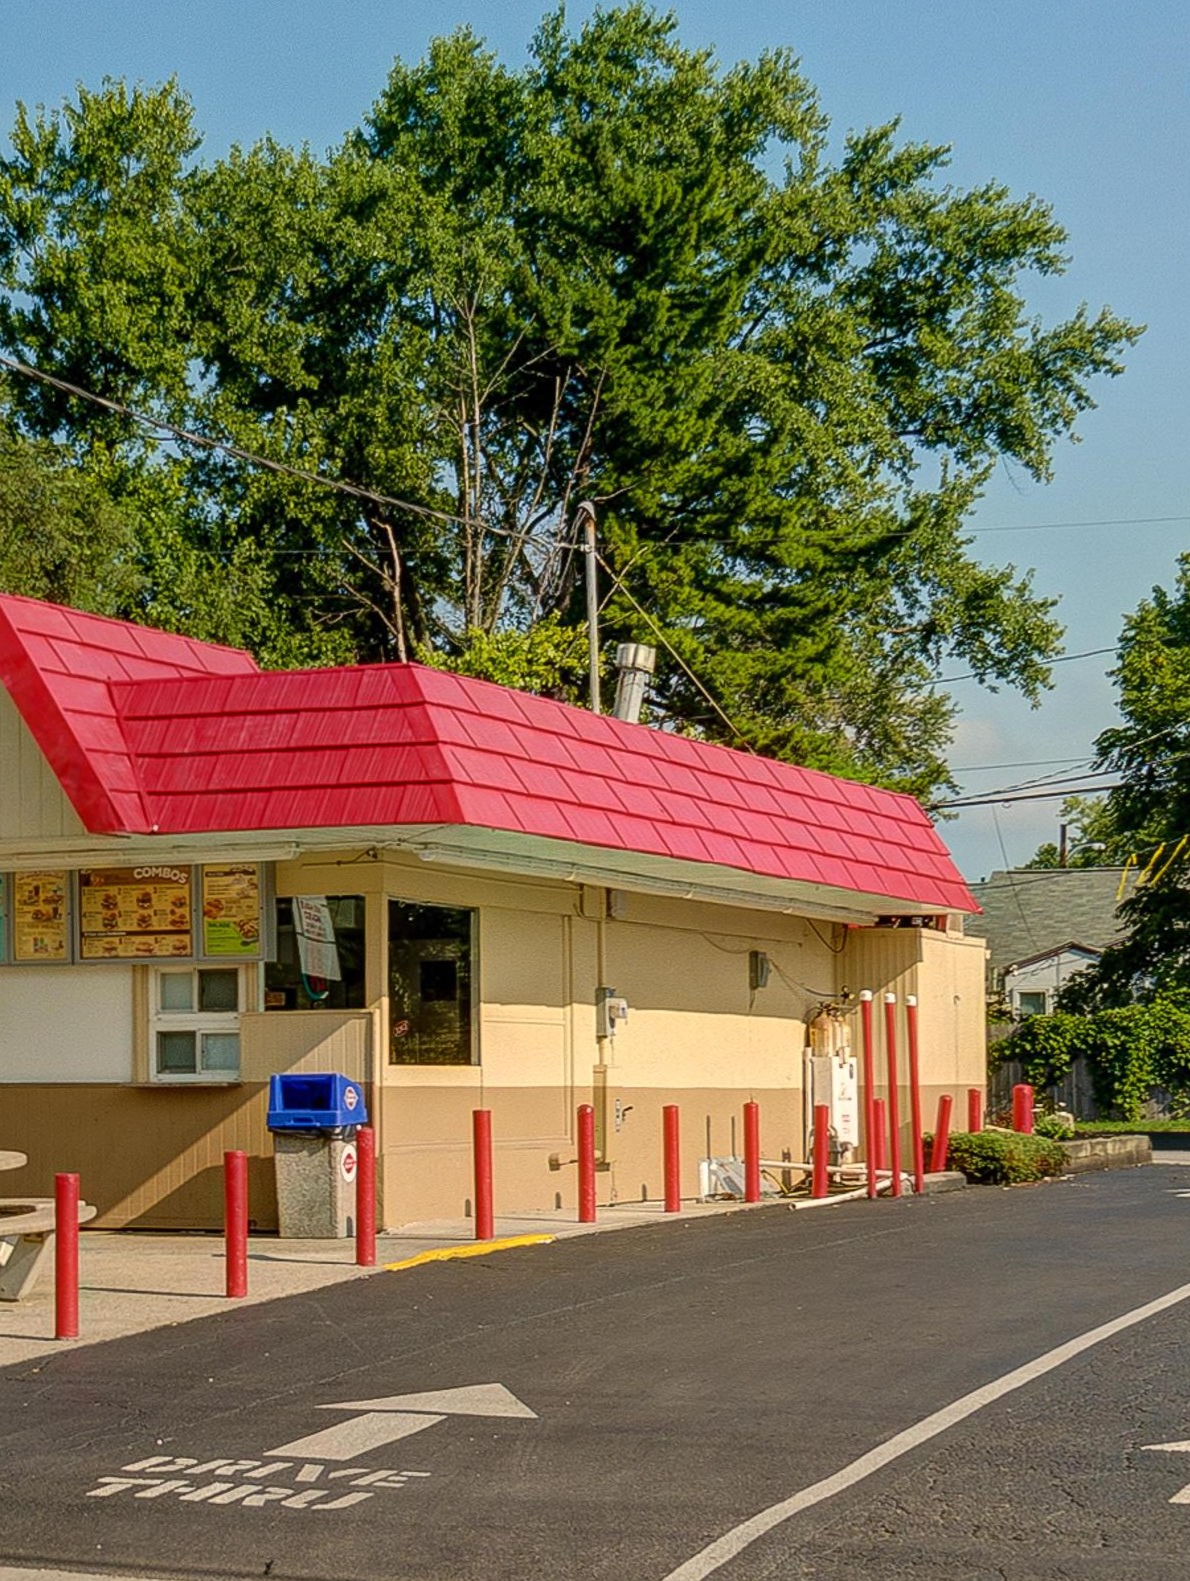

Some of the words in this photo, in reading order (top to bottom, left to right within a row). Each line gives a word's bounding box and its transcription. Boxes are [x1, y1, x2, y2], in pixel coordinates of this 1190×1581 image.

[133, 866, 189, 884] COMBOS
[121, 1456, 432, 1488] DRIVE
[85, 1477, 375, 1510] THRU
